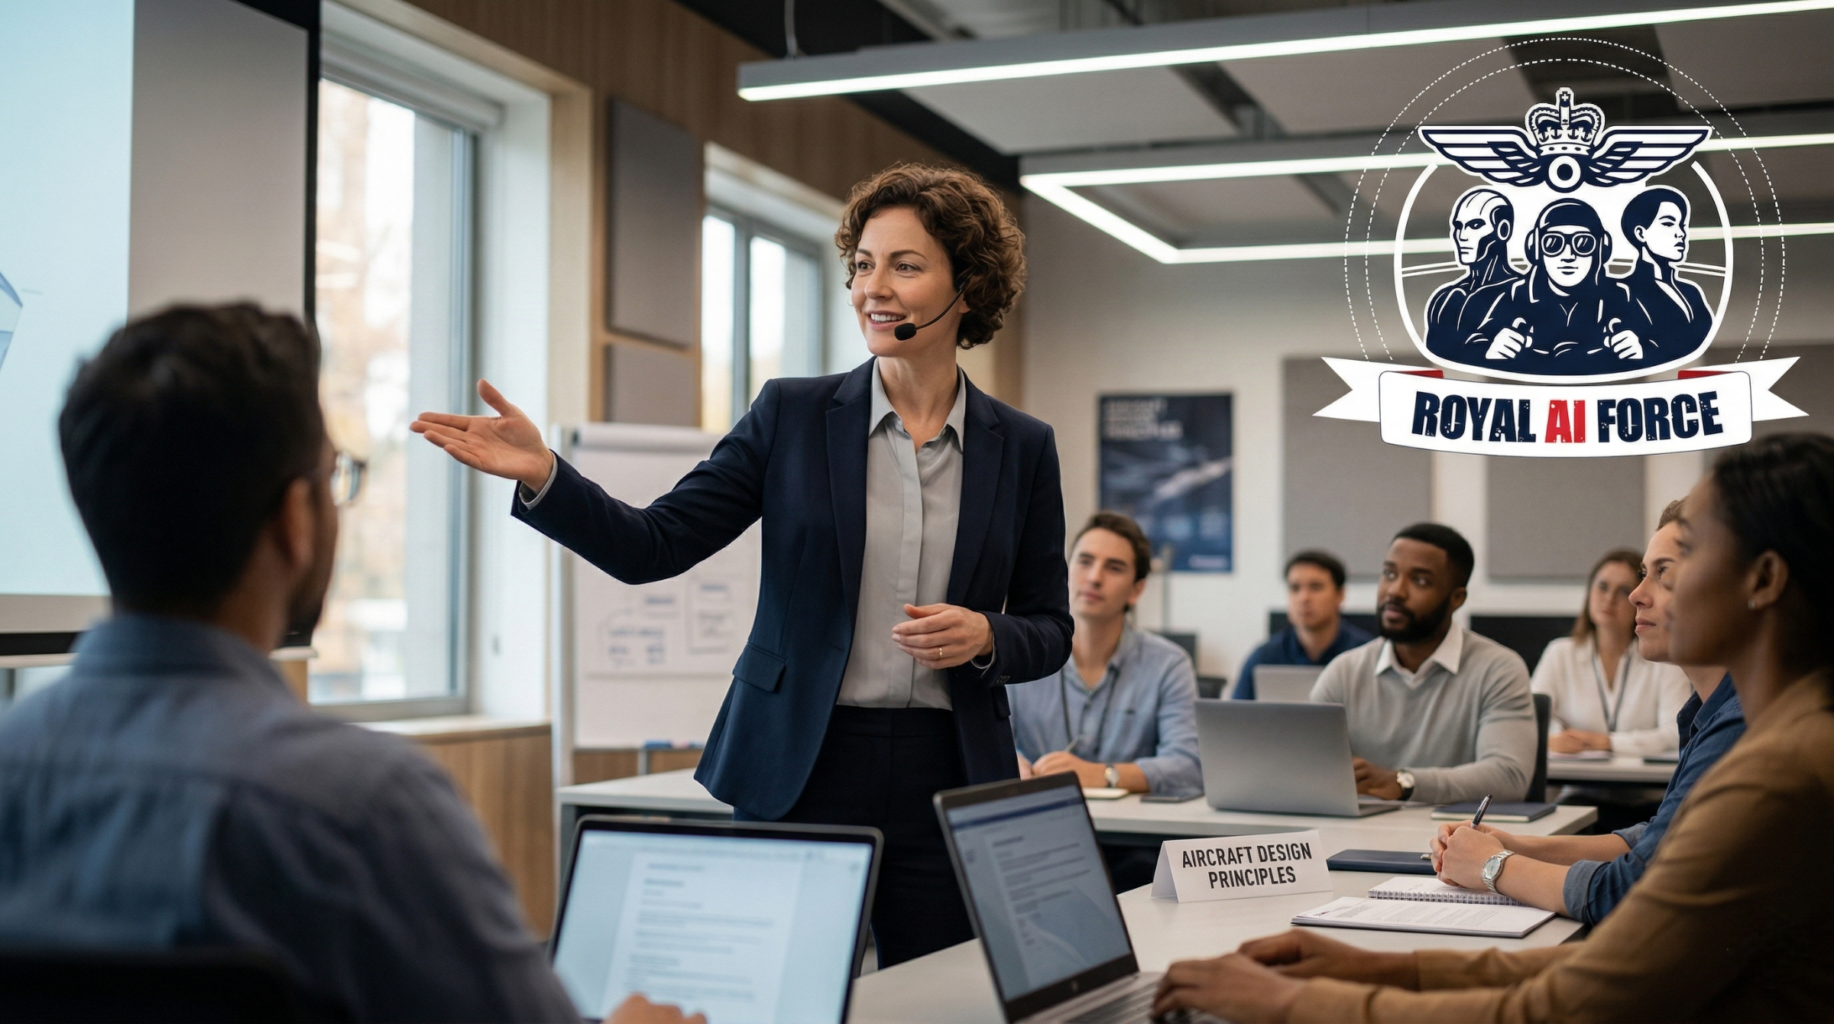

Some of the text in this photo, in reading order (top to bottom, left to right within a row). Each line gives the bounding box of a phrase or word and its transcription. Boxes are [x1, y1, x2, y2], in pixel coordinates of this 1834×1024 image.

[1182, 842, 1312, 868] AIRCRAFT DESIGN
[1208, 866, 1296, 889] PRINCIPLES
